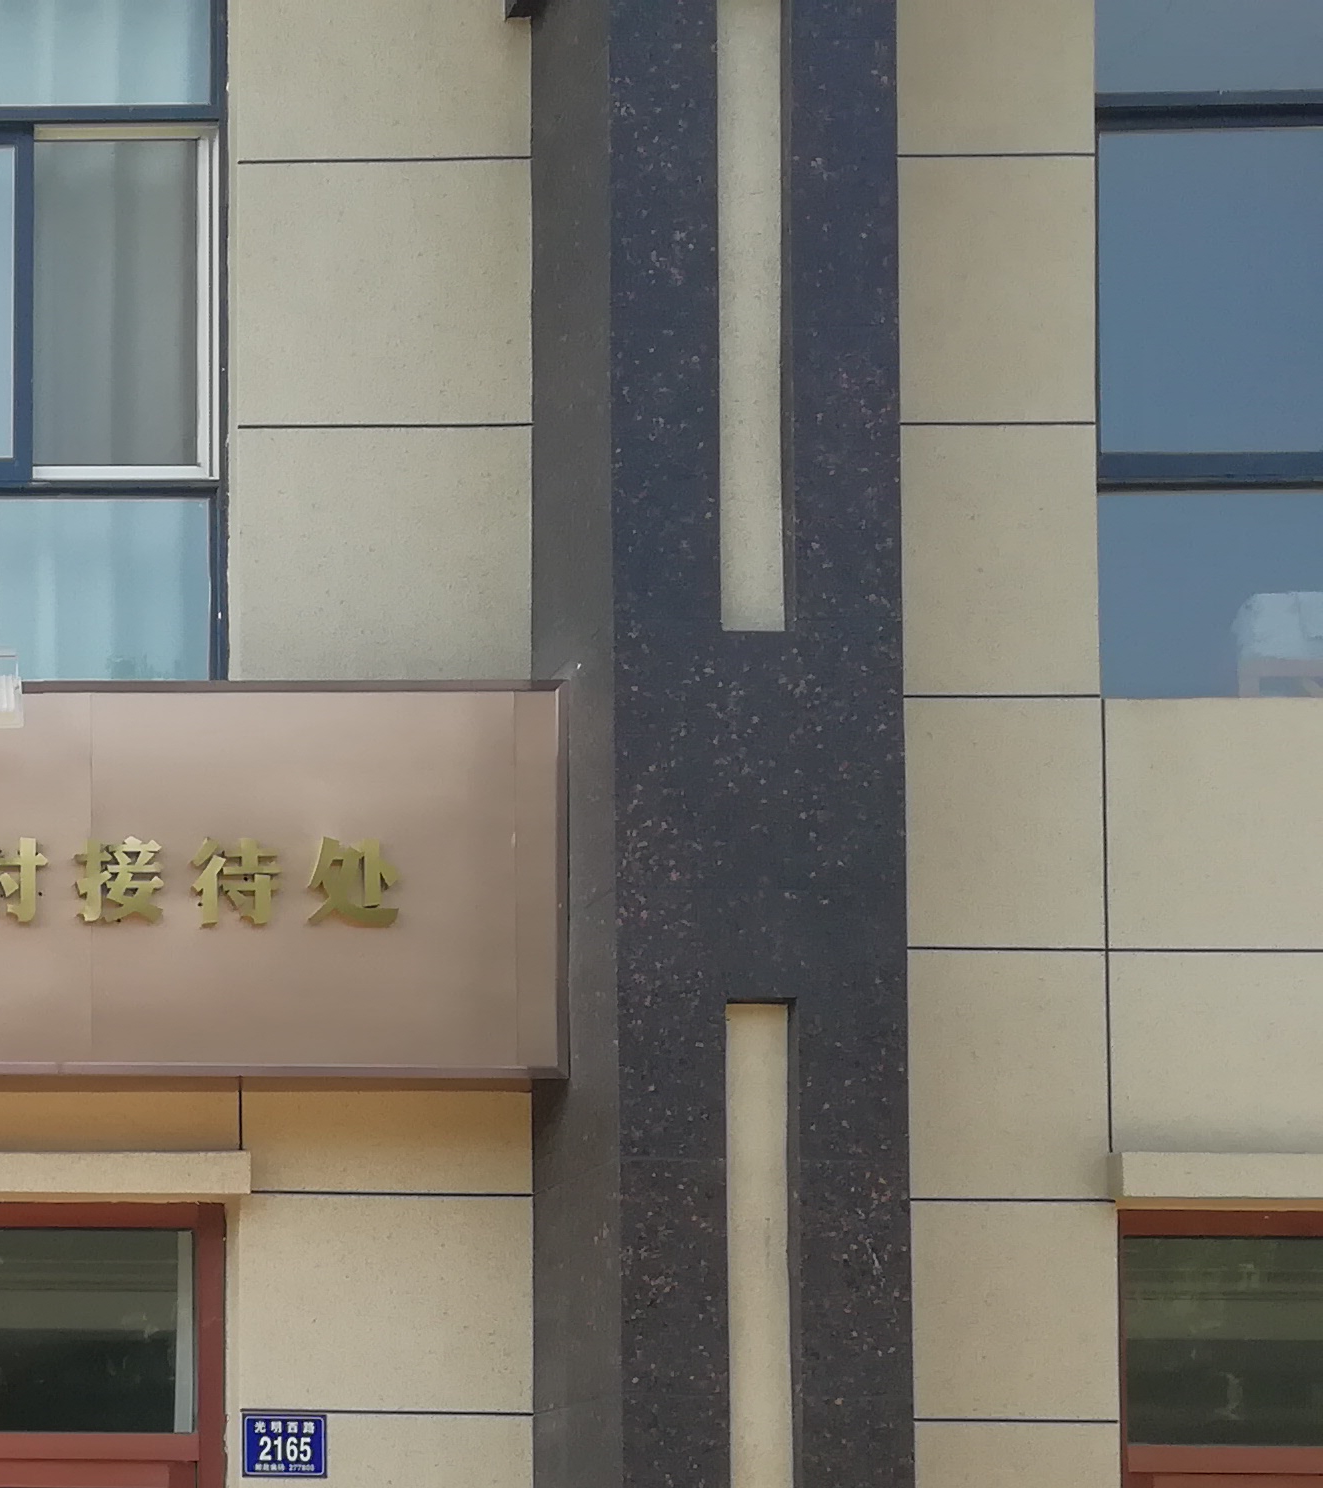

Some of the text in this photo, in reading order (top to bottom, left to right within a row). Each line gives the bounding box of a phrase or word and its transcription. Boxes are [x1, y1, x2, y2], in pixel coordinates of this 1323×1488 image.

[254, 1421, 315, 1434] 光明西路
[259, 1436, 312, 1461] 2165
